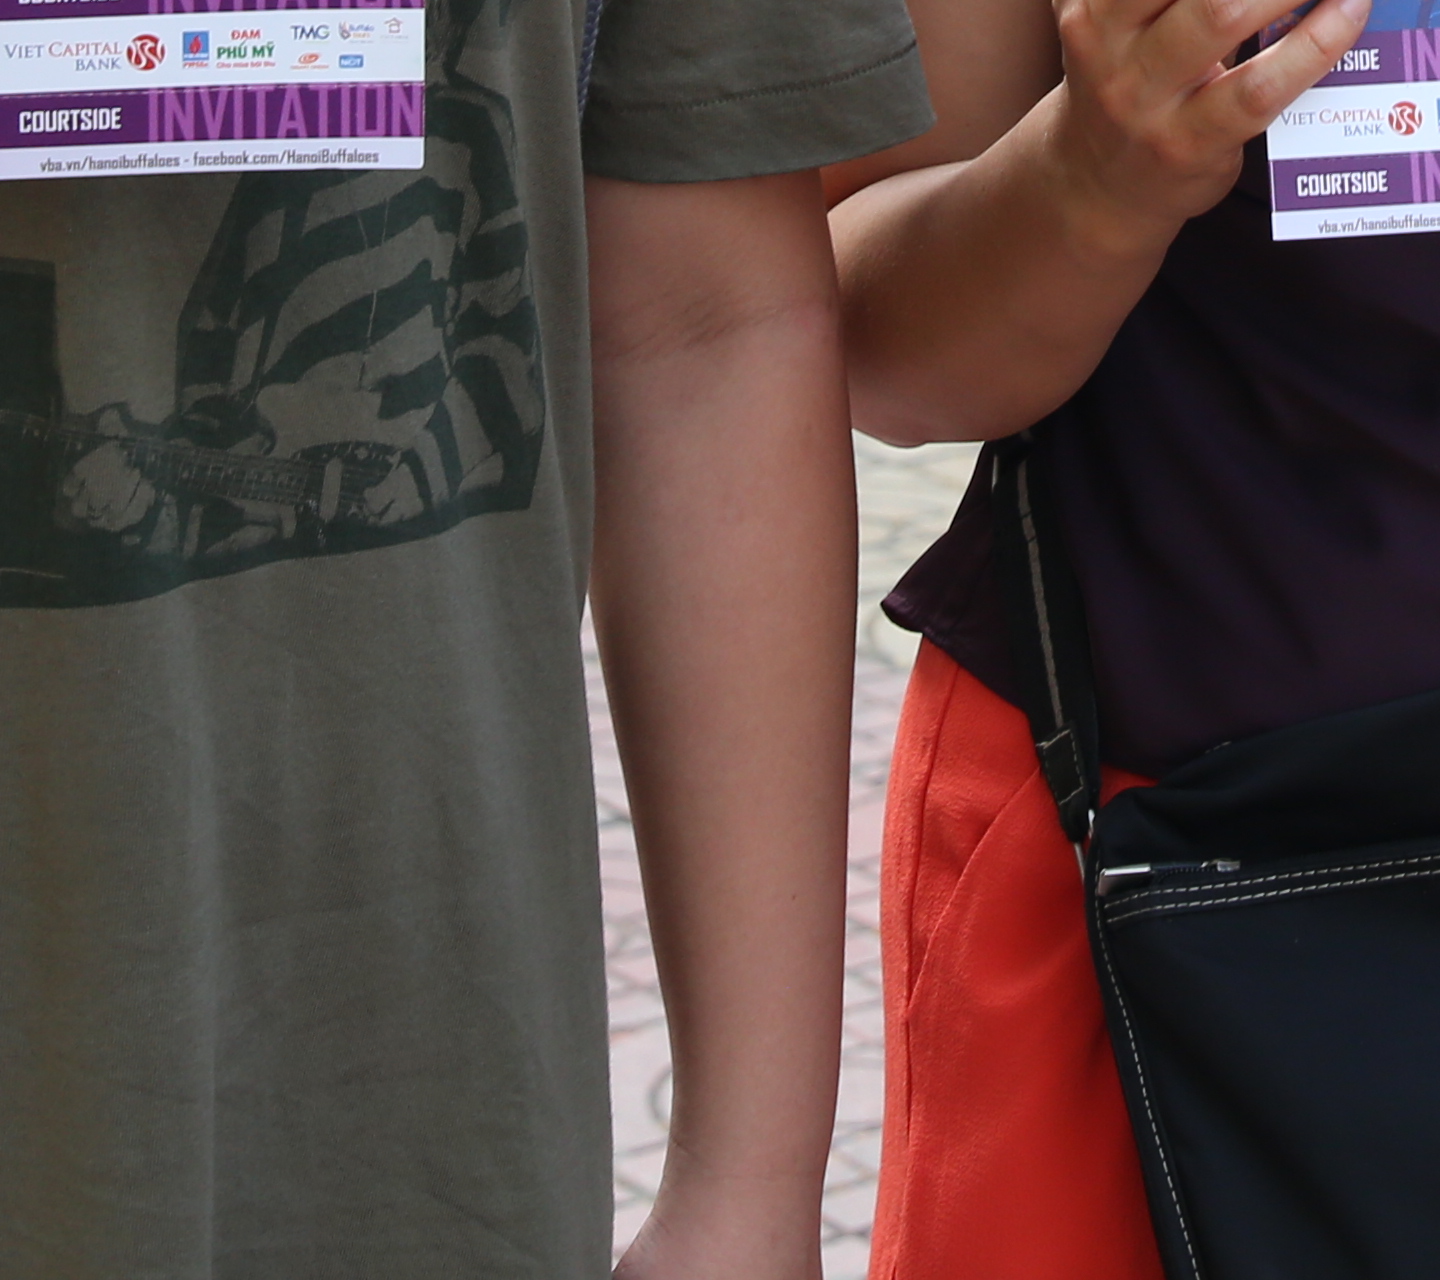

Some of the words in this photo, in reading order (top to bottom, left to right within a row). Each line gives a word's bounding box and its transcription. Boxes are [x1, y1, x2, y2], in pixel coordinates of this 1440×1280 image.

[290, 24, 331, 41] TMG
[4, 44, 45, 59] VIET
[48, 41, 123, 58] CAPITAL
[216, 40, 248, 59] PHÚ
[75, 57, 123, 72] BANK
[19, 108, 122, 134] COURTSIDE
[148, 83, 422, 144] INVITATION
[1280, 111, 1316, 126] VIET
[1319, 109, 1385, 124] CAPITAL
[1343, 123, 1386, 138] BANK
[40, 151, 180, 175] vba.vn/hanoibuffaloes
[192, 148, 380, 170] facebook.com/HanoiBuffaloes
[1297, 170, 1388, 198] COURTSIDE
